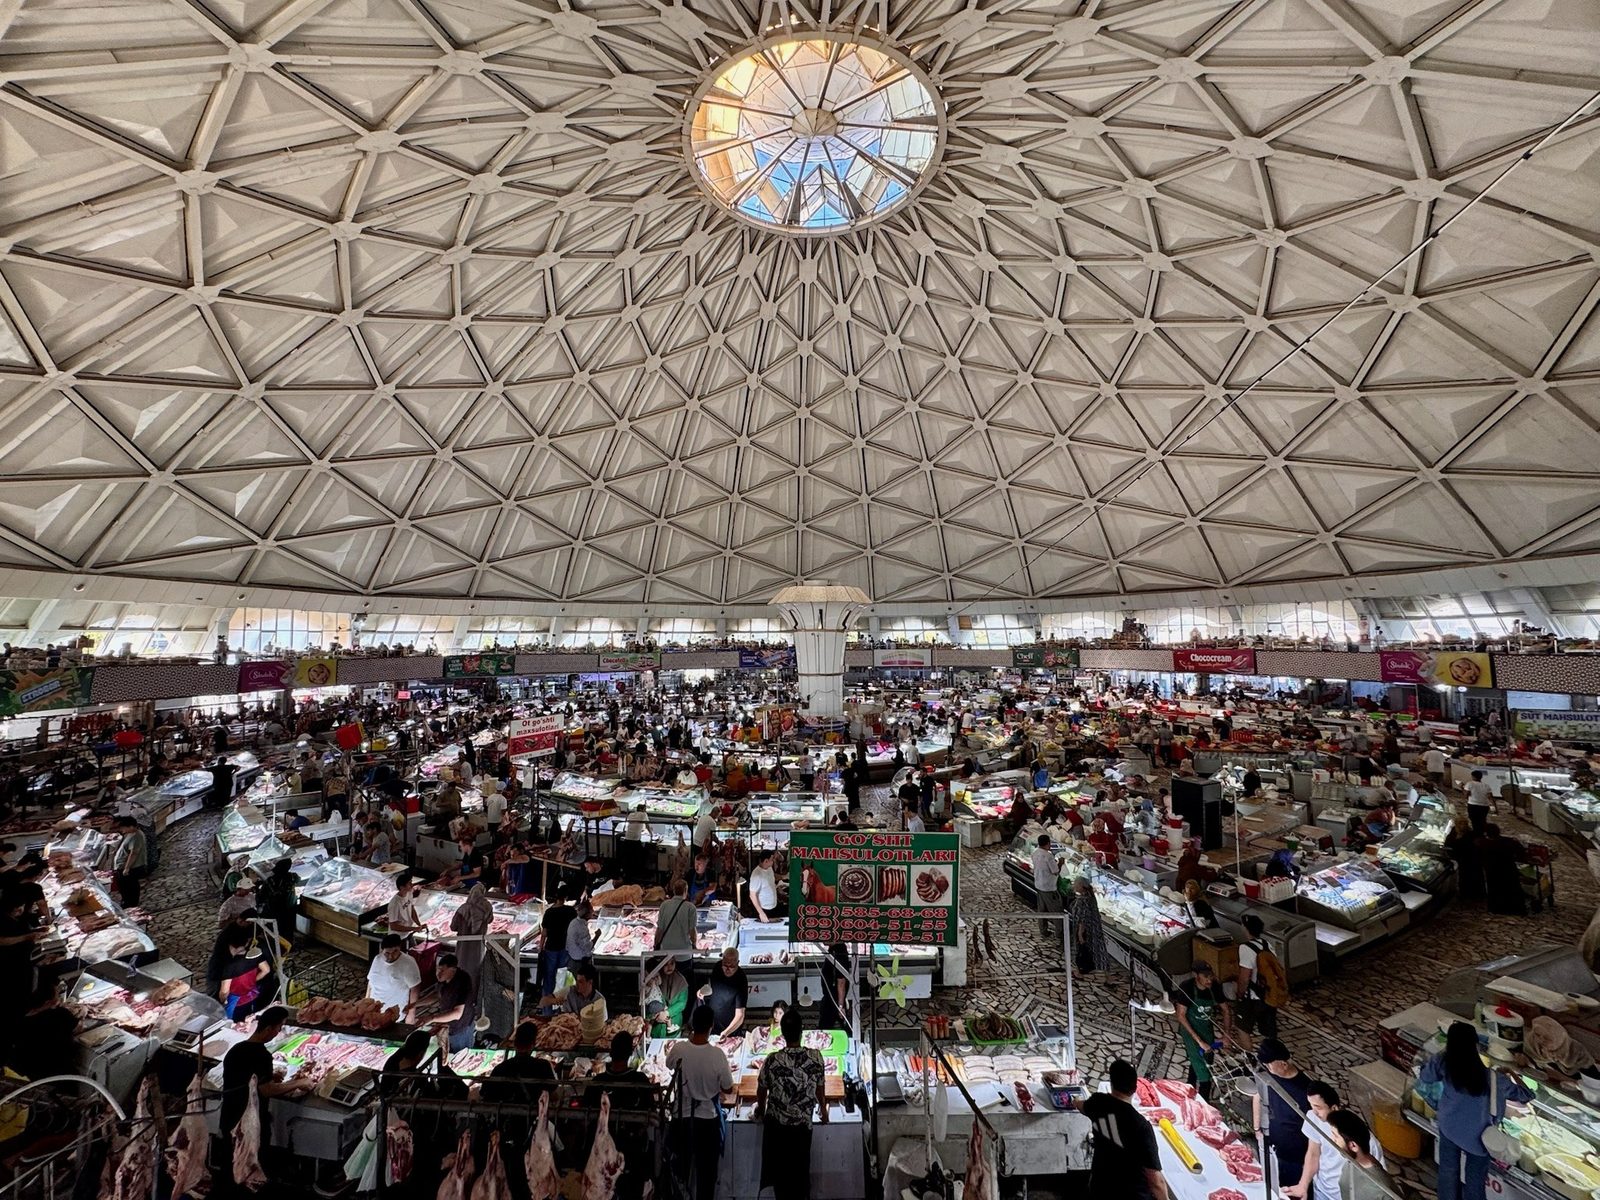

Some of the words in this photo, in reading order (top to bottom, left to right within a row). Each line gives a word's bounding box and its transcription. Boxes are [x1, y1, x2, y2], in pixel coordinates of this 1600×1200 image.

[1190, 653, 1233, 663] Chococream
[1520, 712, 1541, 720] SUT
[516, 724, 559, 736] maxsulotlari
[833, 833, 914, 847] GO'SHT
[791, 847, 957, 862] MAHSULOTLARI
[797, 905, 948, 919] (93)585-68-68
[796, 917, 948, 931] (99)604-51-55
[796, 929, 945, 943] (93)507-55-51
